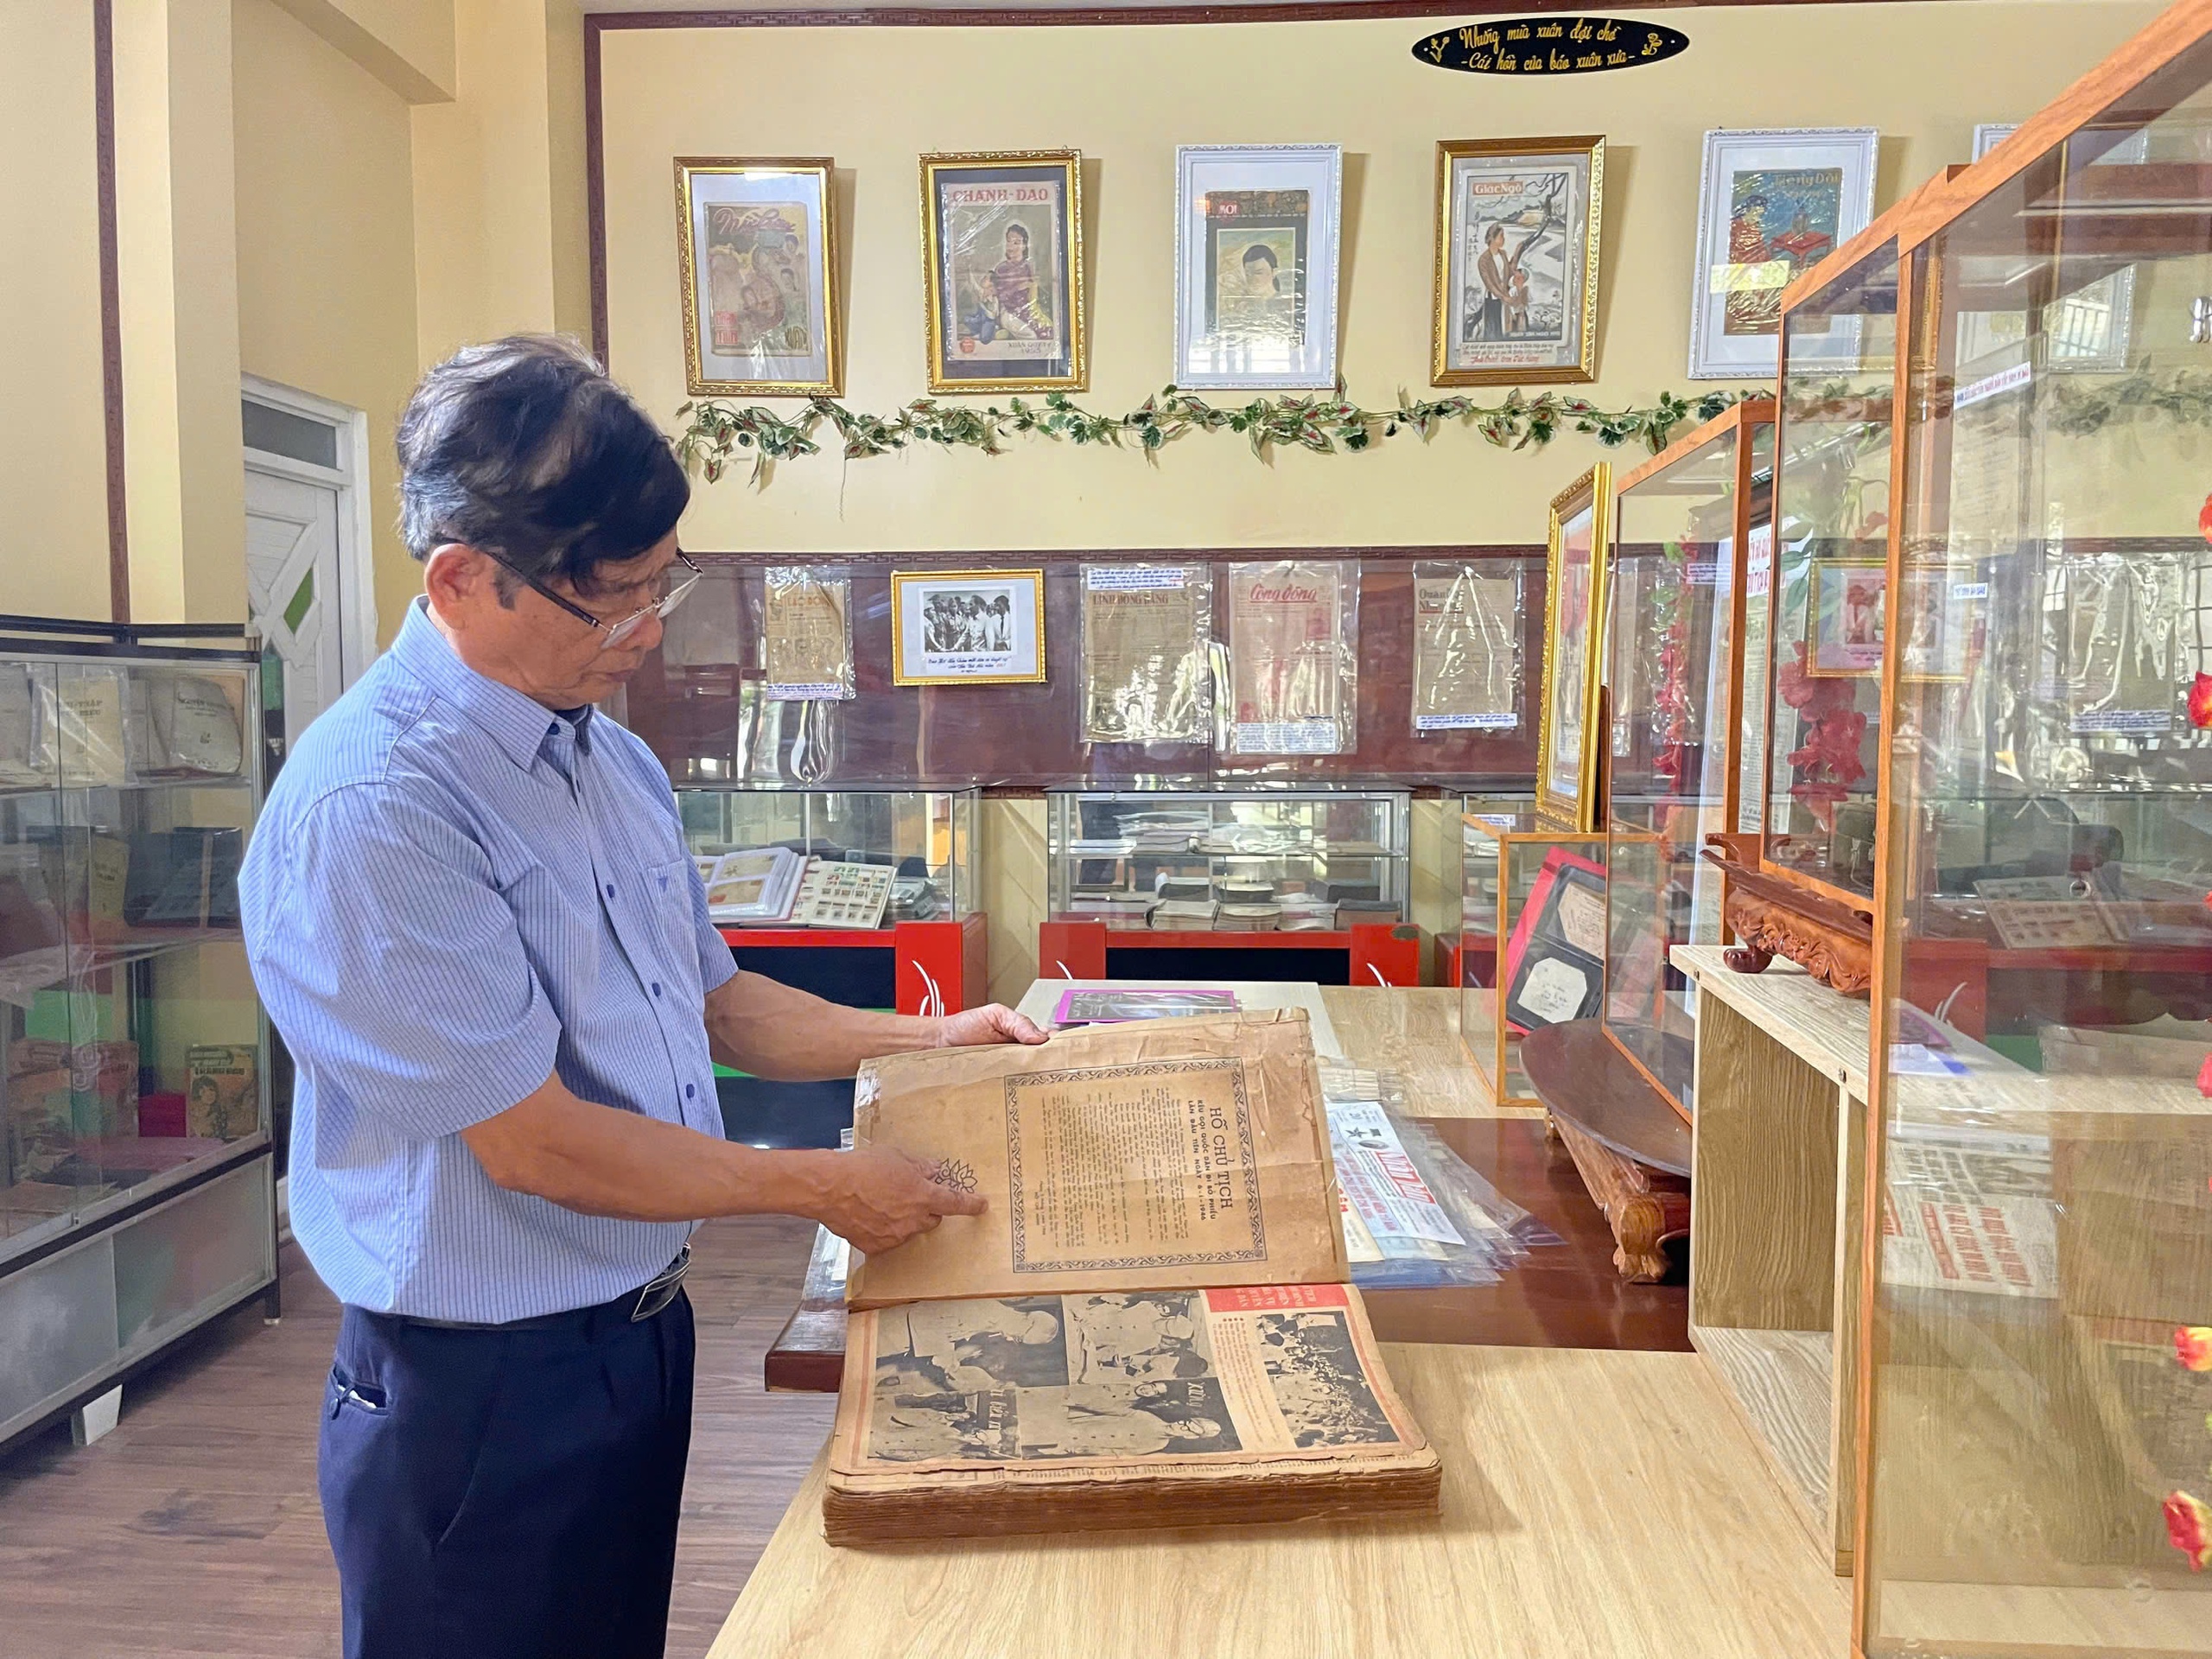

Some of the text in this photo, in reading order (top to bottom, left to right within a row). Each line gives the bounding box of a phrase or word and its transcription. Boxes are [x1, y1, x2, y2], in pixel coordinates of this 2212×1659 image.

[1459, 17, 1622, 54] Những mùa xuân đợi chờ
[1497, 48, 1516, 71] hồn
[1523, 54, 1542, 71] của
[1549, 48, 1570, 71] báo
[1576, 52, 1603, 68] xuân
[1200, 1132, 1210, 1153] QUỐC
[1212, 1135, 1235, 1166] CHỦ
[1214, 1170, 1233, 1209] TỊCH
